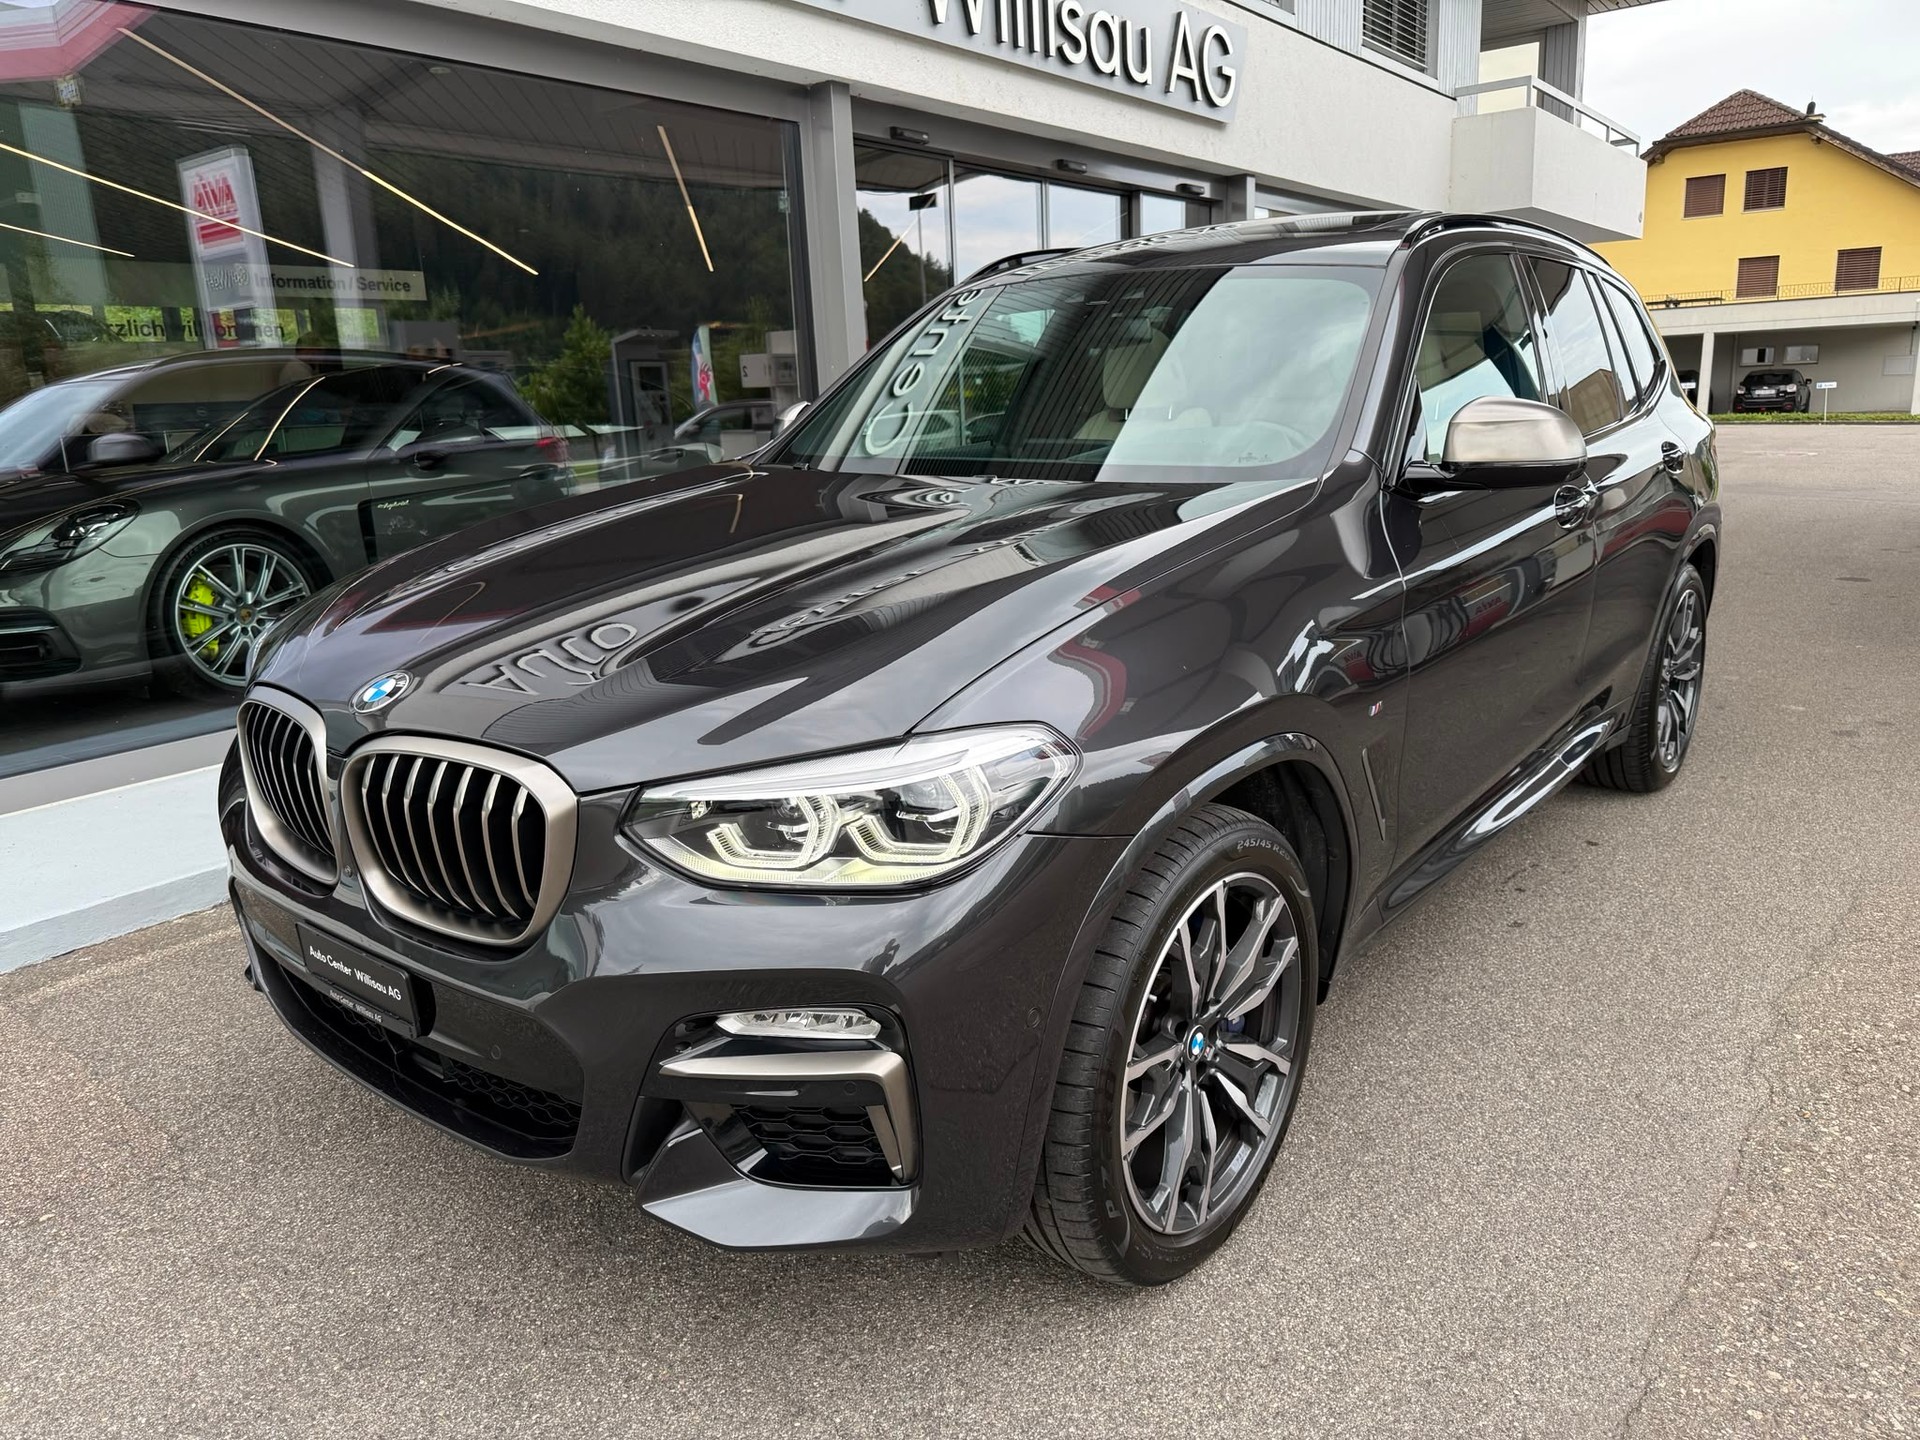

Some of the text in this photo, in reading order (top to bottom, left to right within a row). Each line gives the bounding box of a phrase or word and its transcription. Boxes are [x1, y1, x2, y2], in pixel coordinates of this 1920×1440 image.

[1165, 10, 1236, 108] AG
[254, 274, 346, 291] Information
[357, 275, 411, 293] Service
[1236, 838, 1272, 852] 245/45
[309, 945, 402, 1001] Auto Center Willisau AG
